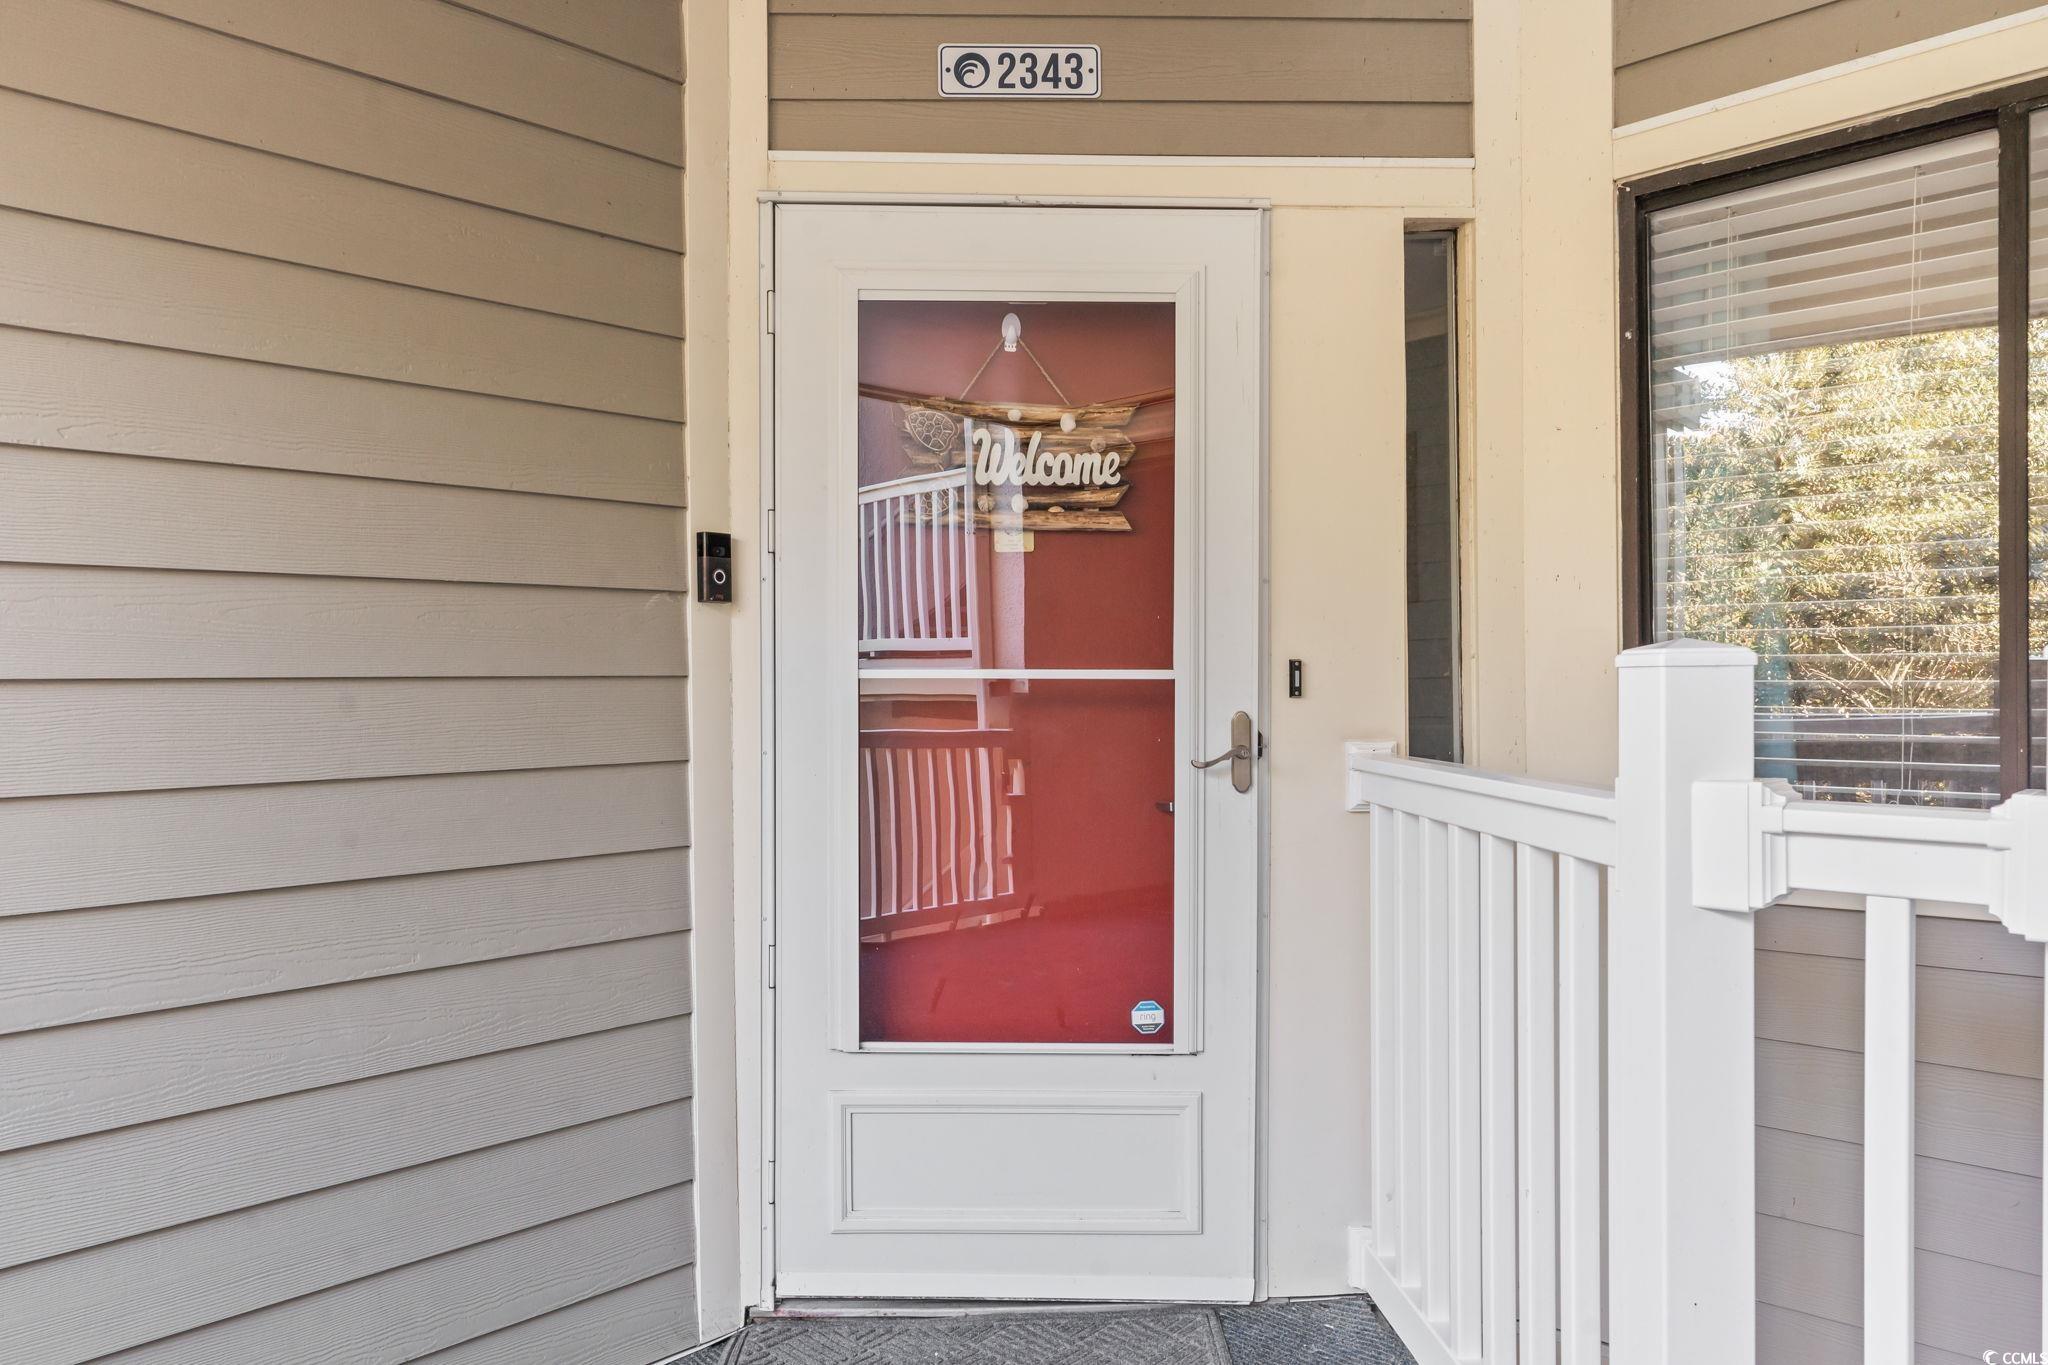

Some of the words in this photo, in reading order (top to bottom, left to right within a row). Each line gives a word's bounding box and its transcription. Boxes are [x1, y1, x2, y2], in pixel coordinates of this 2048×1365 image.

[997, 52, 1083, 89] 2343
[973, 428, 1121, 486] Welcome
[1139, 1013, 1157, 1023] ring
